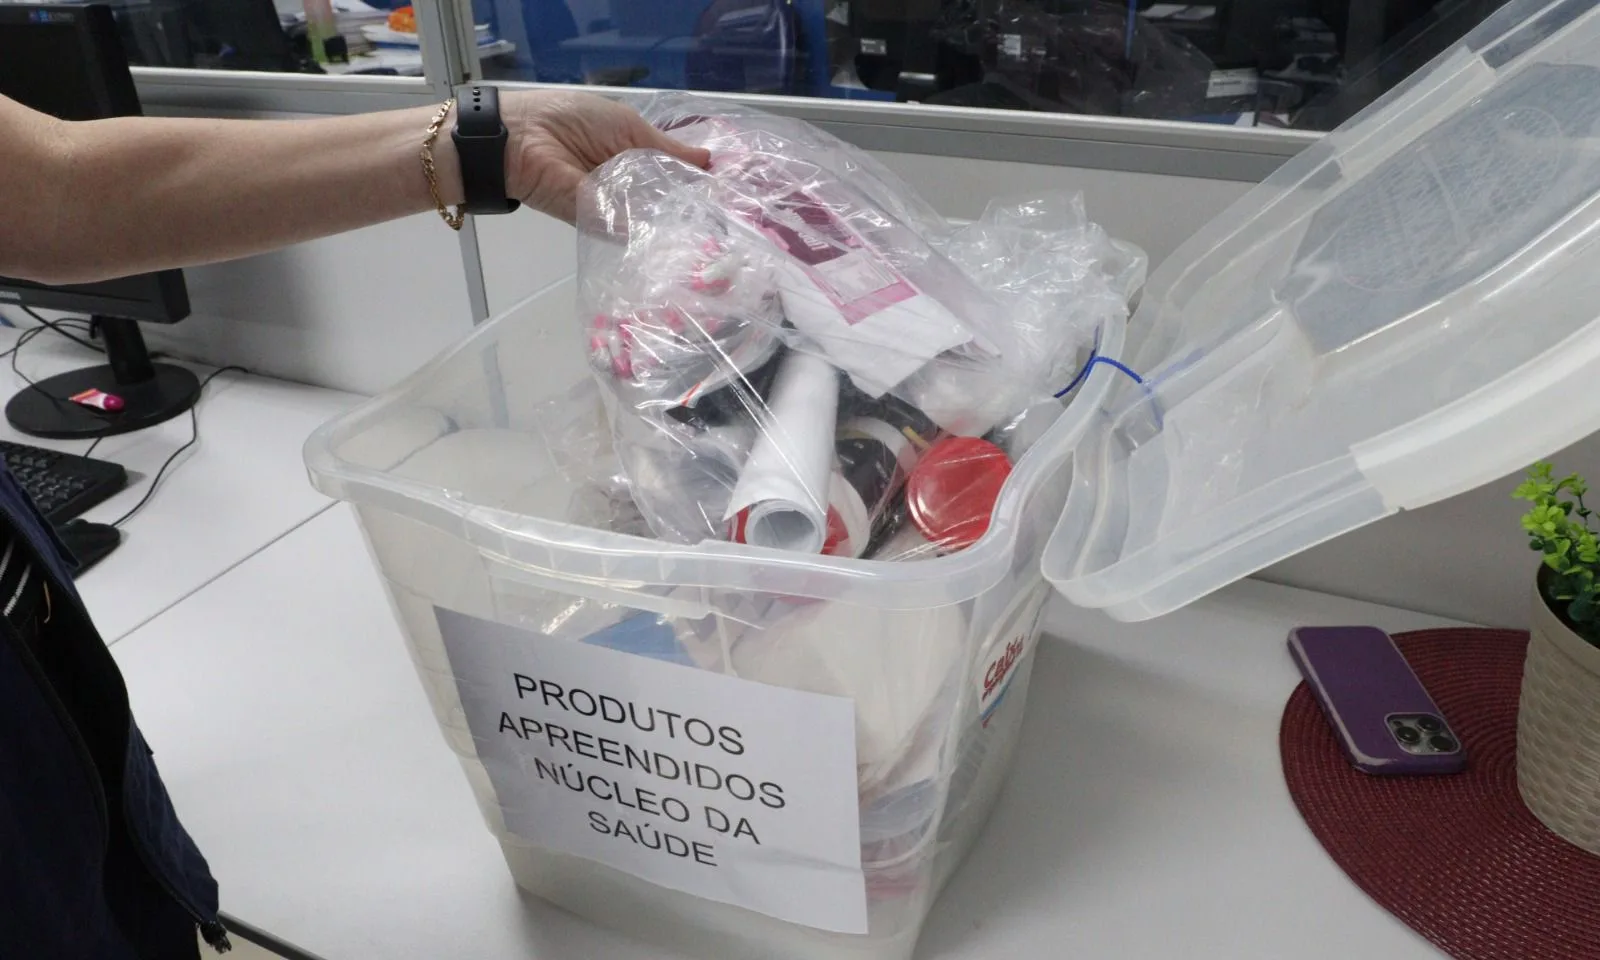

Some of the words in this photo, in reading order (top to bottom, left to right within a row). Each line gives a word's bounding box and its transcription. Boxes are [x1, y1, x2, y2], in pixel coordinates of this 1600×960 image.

[512, 672, 745, 756] PRODUTOS
[498, 711, 787, 810] APREENDIDOS
[533, 756, 691, 823] NÚCLEO
[703, 805, 762, 846] DA
[587, 810, 719, 868] SAÚDE
